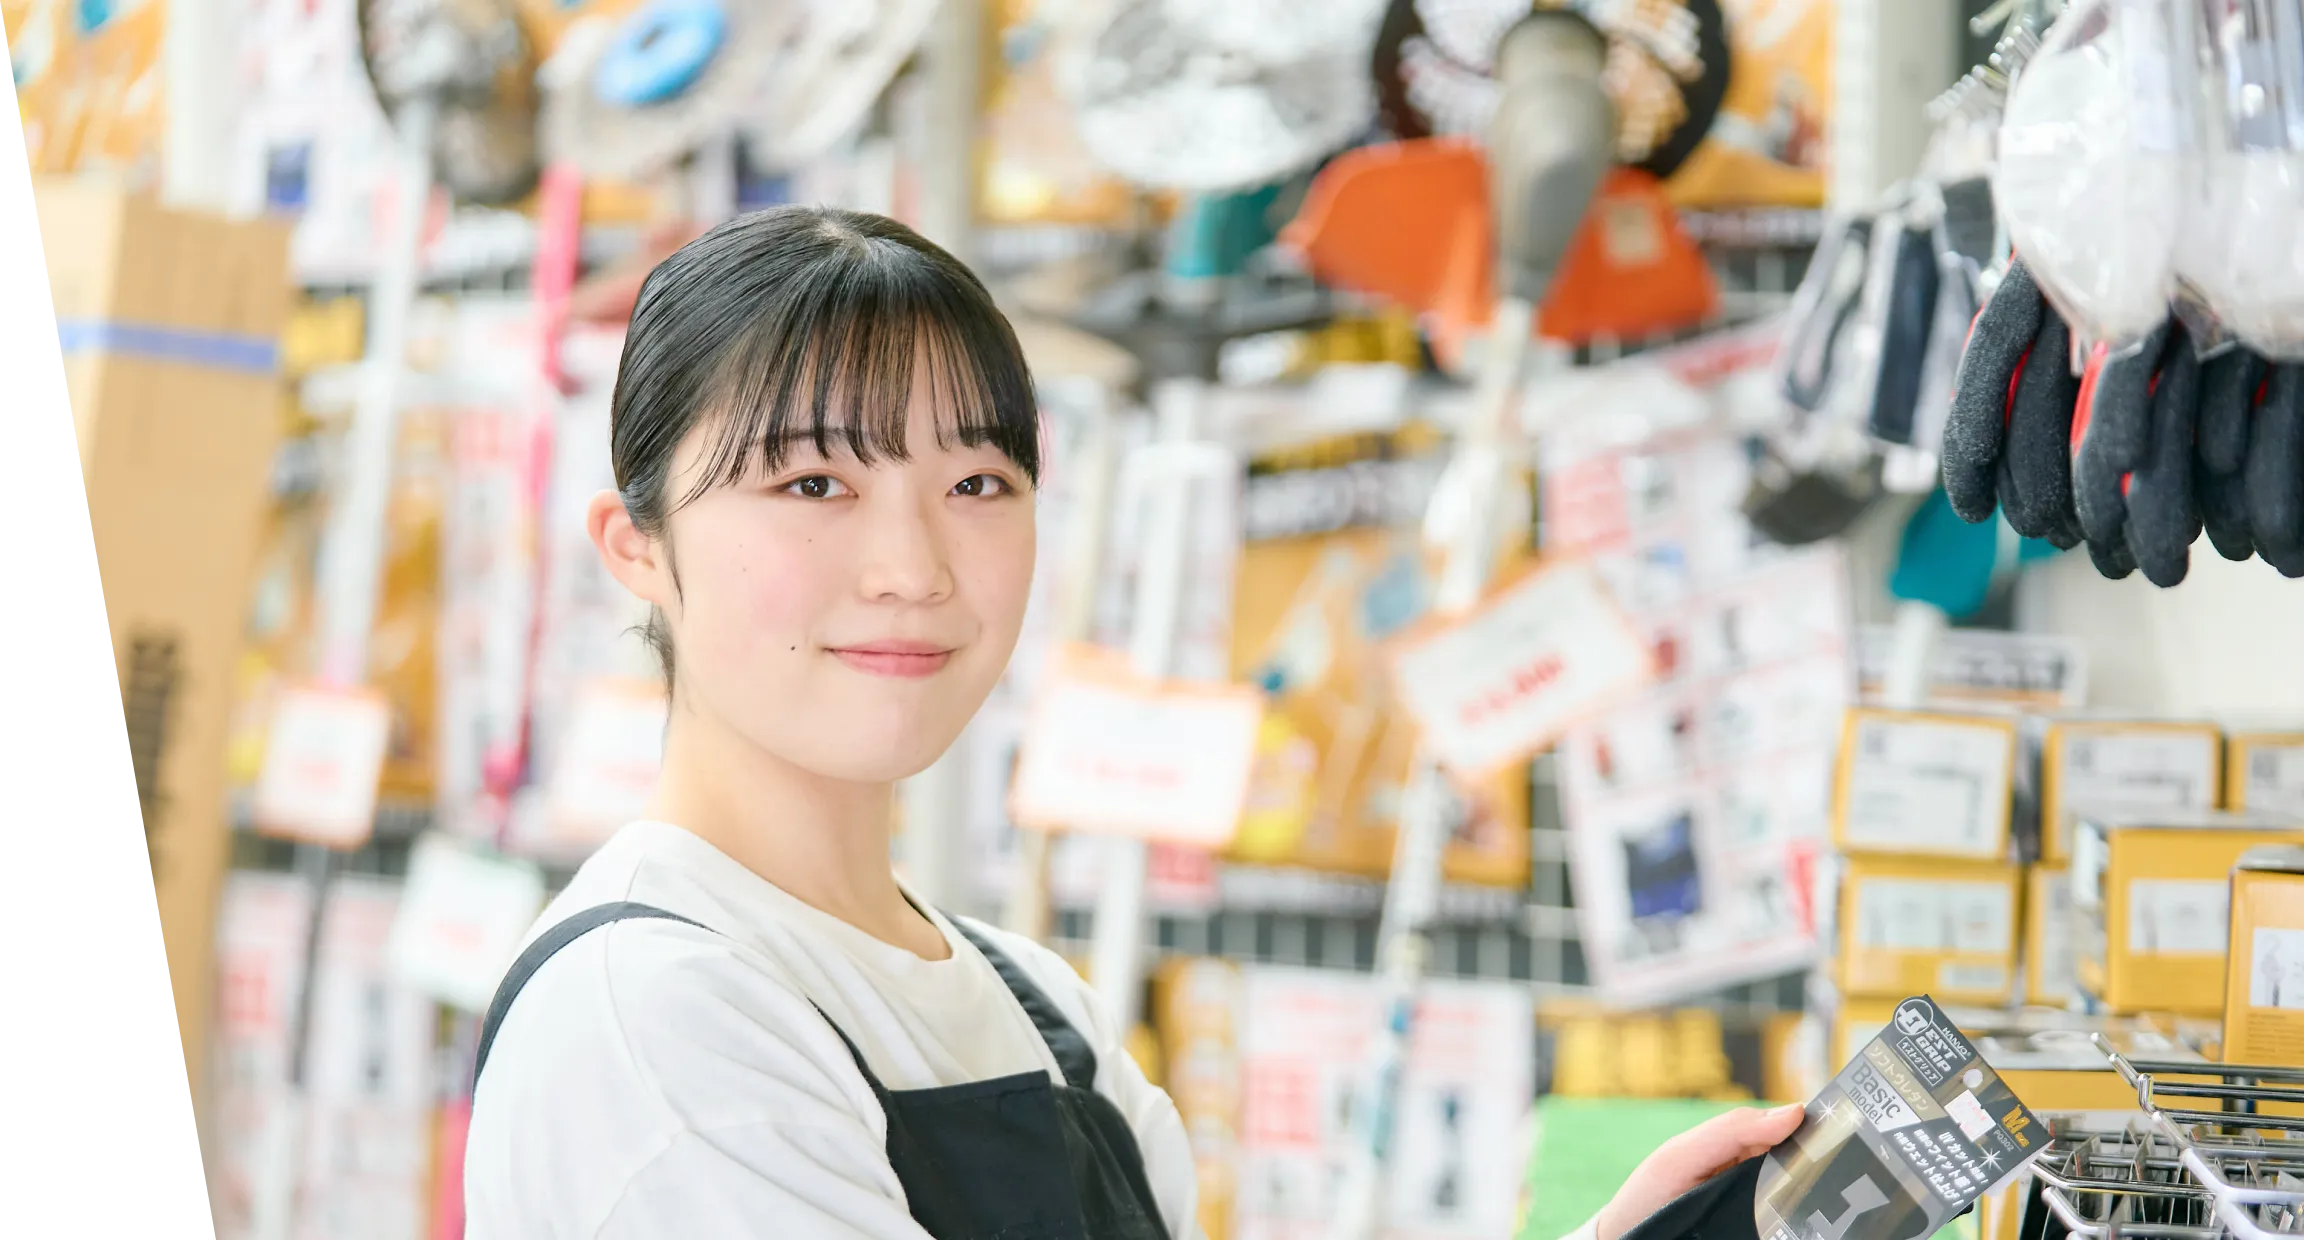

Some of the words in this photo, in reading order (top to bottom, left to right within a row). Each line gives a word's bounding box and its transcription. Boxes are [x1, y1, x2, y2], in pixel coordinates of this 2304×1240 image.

[1900, 1041, 1938, 1081] ベストグリップ
[1915, 1036, 1951, 1072] GRIP
[1851, 1062, 1901, 1119] Basic
[1871, 1046, 1930, 1111] ソフトウレタン
[1849, 1087, 1883, 1125] model
[2001, 1104, 2030, 1132] M
